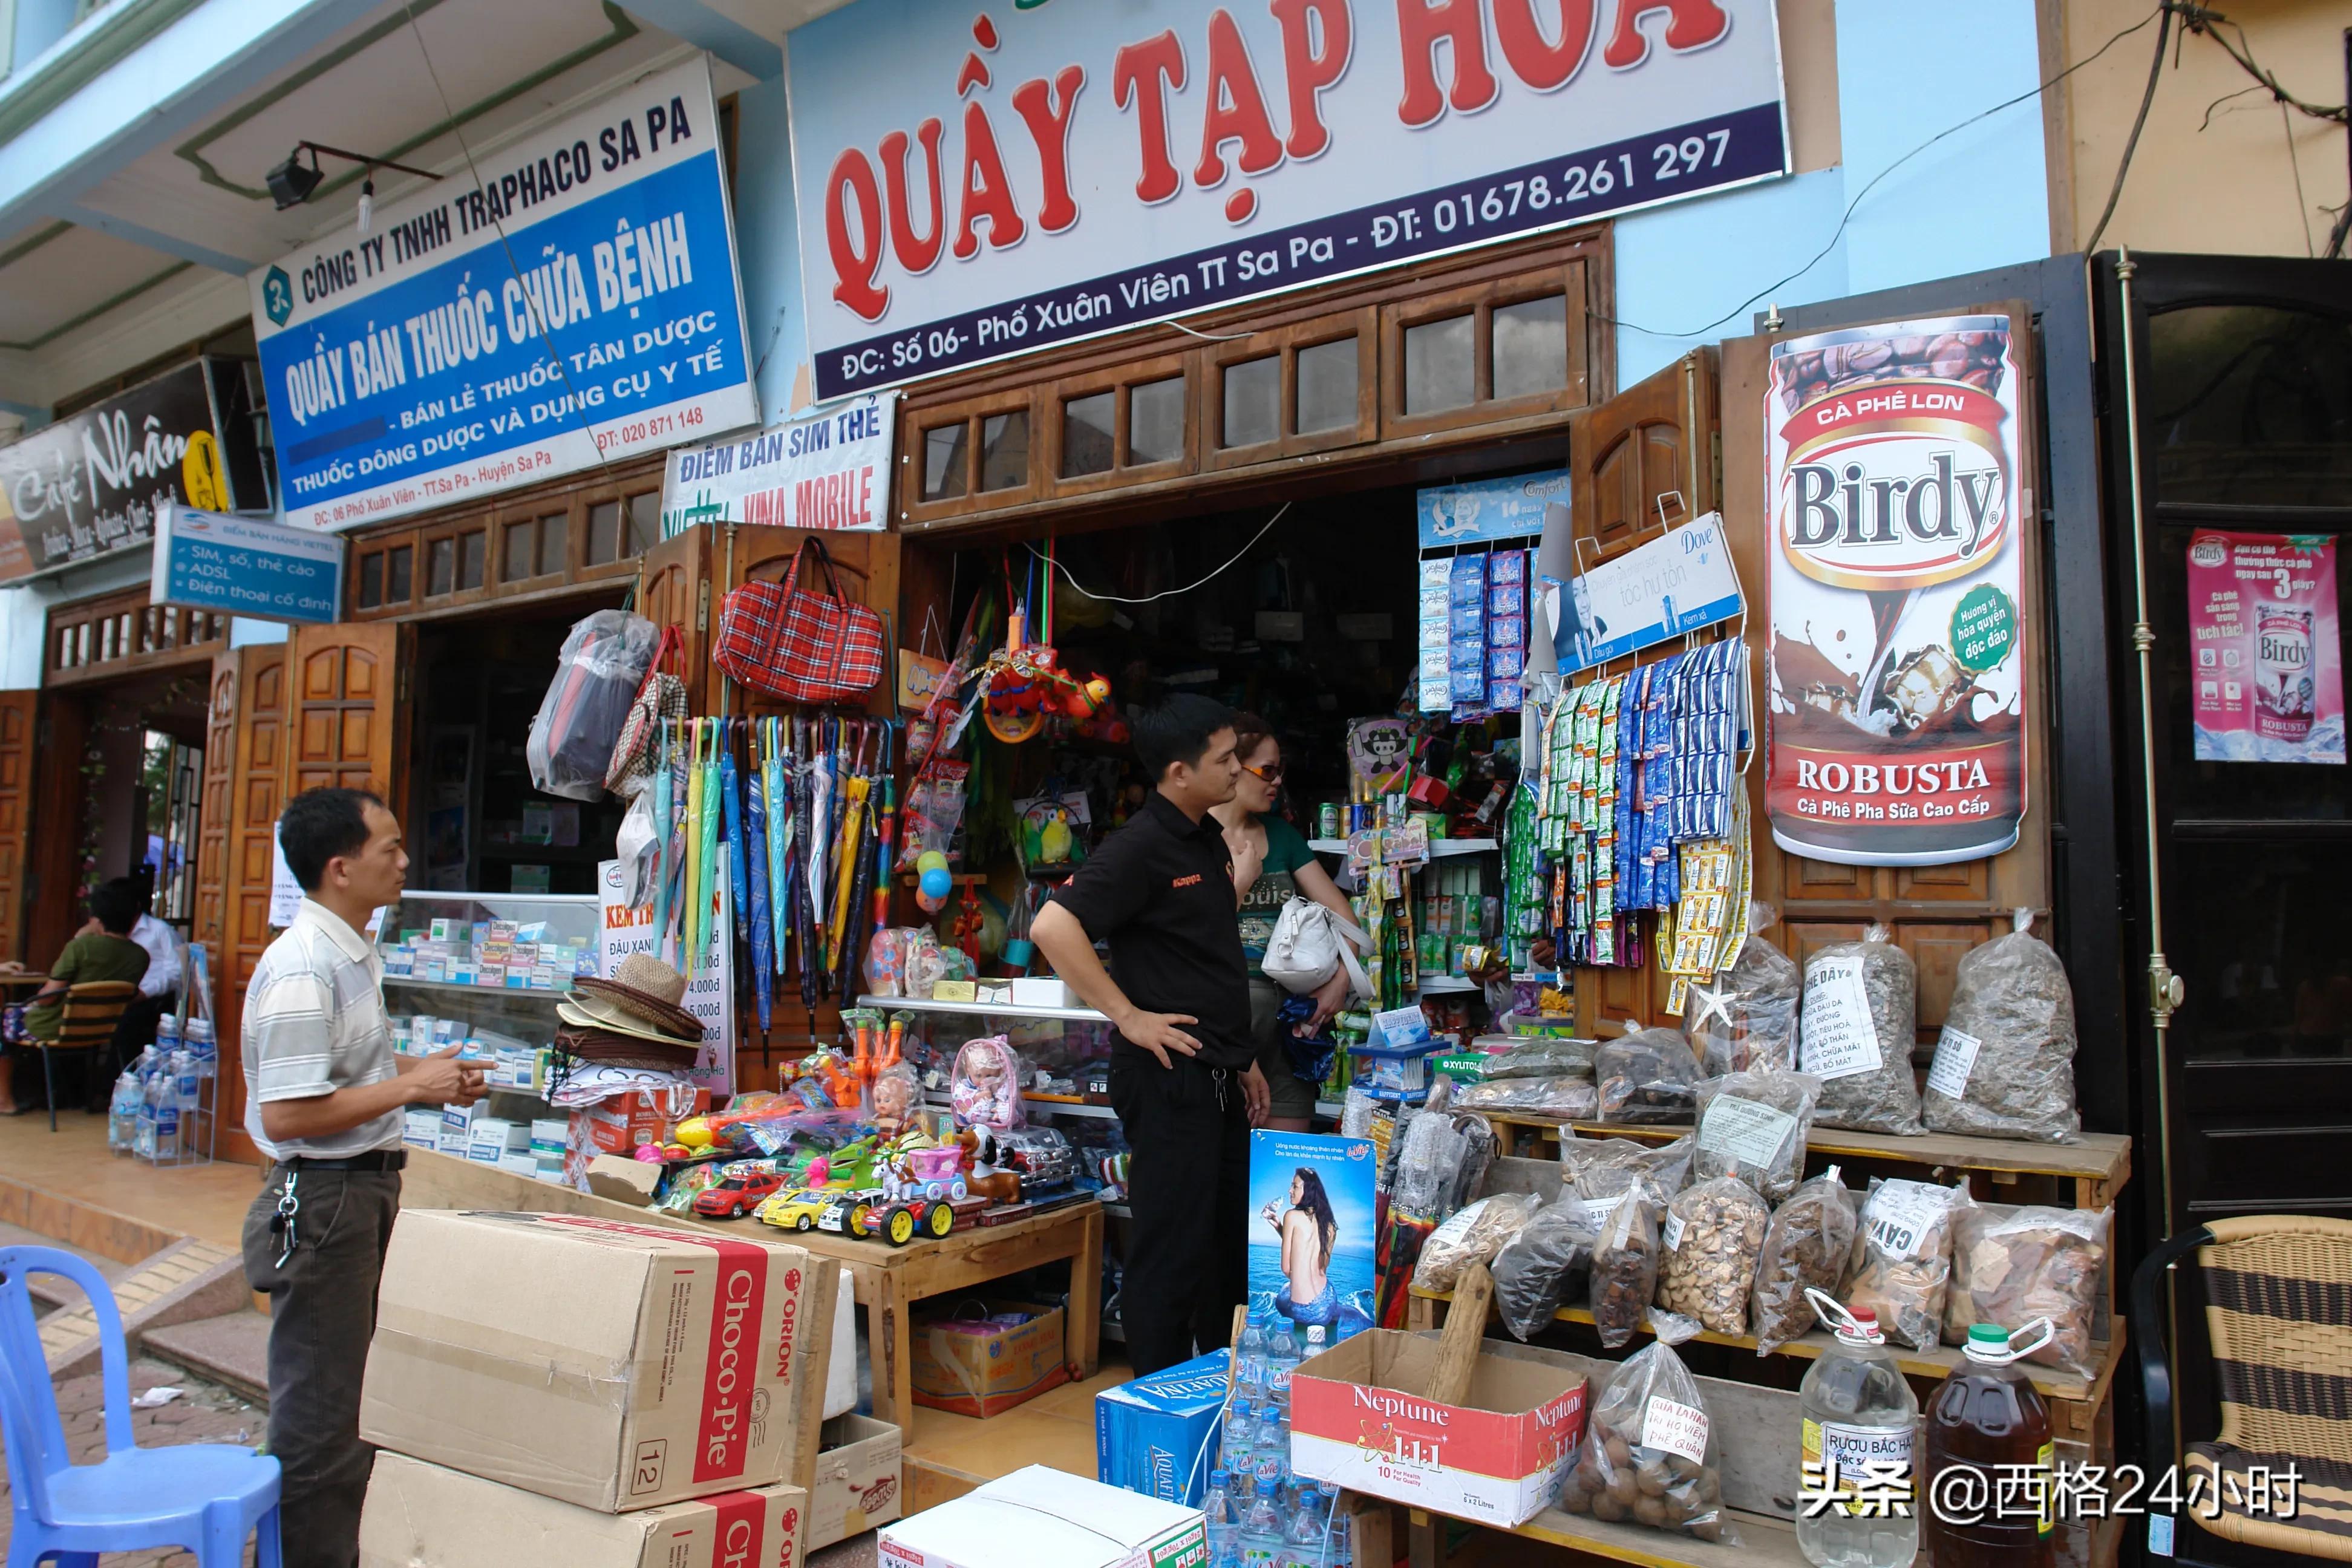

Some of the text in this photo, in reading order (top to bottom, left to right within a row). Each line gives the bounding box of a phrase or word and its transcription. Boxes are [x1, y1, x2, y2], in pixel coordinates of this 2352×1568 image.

[825, 13, 1086, 321] QUẦY
[1115, 0, 1354, 224] TẠP
[301, 95, 693, 305] CÔNG TY TNHH TRAPHACO SA PA
[841, 128, 1733, 381] ĐC: Số 06- Phố Xuân Viên TT Sa Pa ĐT: 01678.261 297
[286, 217, 693, 424] QUẦY BÁN THUỐC CHỮA BỆNH
[400, 310, 717, 431] BÁN LẺ THUỐC TÂN DƯỢC
[292, 339, 725, 495] THUỐC ĐÔNG DƯỢC VÀ DỤNG CỤ Y TẾ
[1817, 390, 1964, 425] CÀ PHÊ LON
[596, 407, 704, 451] ĐT: 020 871 148
[680, 443, 734, 483] ĐIỂM
[788, 419, 830, 457] SIM
[837, 394, 881, 444] THẺ
[82, 409, 189, 508] Nhân
[314, 451, 552, 527] ĐC: 06 Phố Xuân Viên TT.Sa Pa Huyện Sa Pa
[796, 466, 874, 530] MOBILE
[1523, 477, 1567, 500] Comfort
[1789, 451, 2001, 559] Birdy
[1681, 527, 1713, 554] Dove
[189, 563, 231, 580] ADSL
[192, 545, 223, 564] SIM,
[258, 558, 283, 572] thẻ
[287, 563, 316, 577] cào
[1493, 571, 1519, 582] Comfort
[2257, 570, 2272, 579] sau
[2274, 569, 2291, 599] 3
[189, 578, 225, 595] Điện
[230, 586, 270, 603] thoại
[275, 592, 295, 606] cố
[298, 599, 332, 611] định
[1493, 602, 1519, 614] Comfort
[1620, 584, 1641, 607] tóc
[1961, 595, 1996, 623] Hương vị
[1683, 615, 1698, 626] Kem
[1958, 606, 2006, 641] hòa quyện
[1493, 634, 1519, 646] Comfort
[1965, 628, 2008, 661] độc đáo
[2260, 637, 2309, 668] Birdy
[1493, 665, 1519, 678] Comfort
[1493, 697, 1519, 710] Comfort
[2262, 719, 2307, 731] ROBUSTA
[1797, 757, 1990, 795] ROBUSTA
[1797, 794, 1990, 819] Cà Phê Pha Sữa Cao Cấp
[1172, 874, 1203, 888] Kappa
[606, 904, 634, 930] KEM
[610, 939, 629, 958] ĐẬU
[689, 978, 720, 994] 4.000đ
[1821, 967, 1844, 984] DÂY
[774, 1297, 796, 1378] ORION
[1353, 1385, 1450, 1426] Neptune
[1829, 1435, 1896, 1454] RƯỢU BẮC
[636, 1448, 661, 1485] 12
[1377, 1466, 1391, 1478] 10
[1403, 1471, 1421, 1480] Health
[1403, 1477, 1421, 1487] Quality
[1478, 1500, 1495, 1510] Litres
